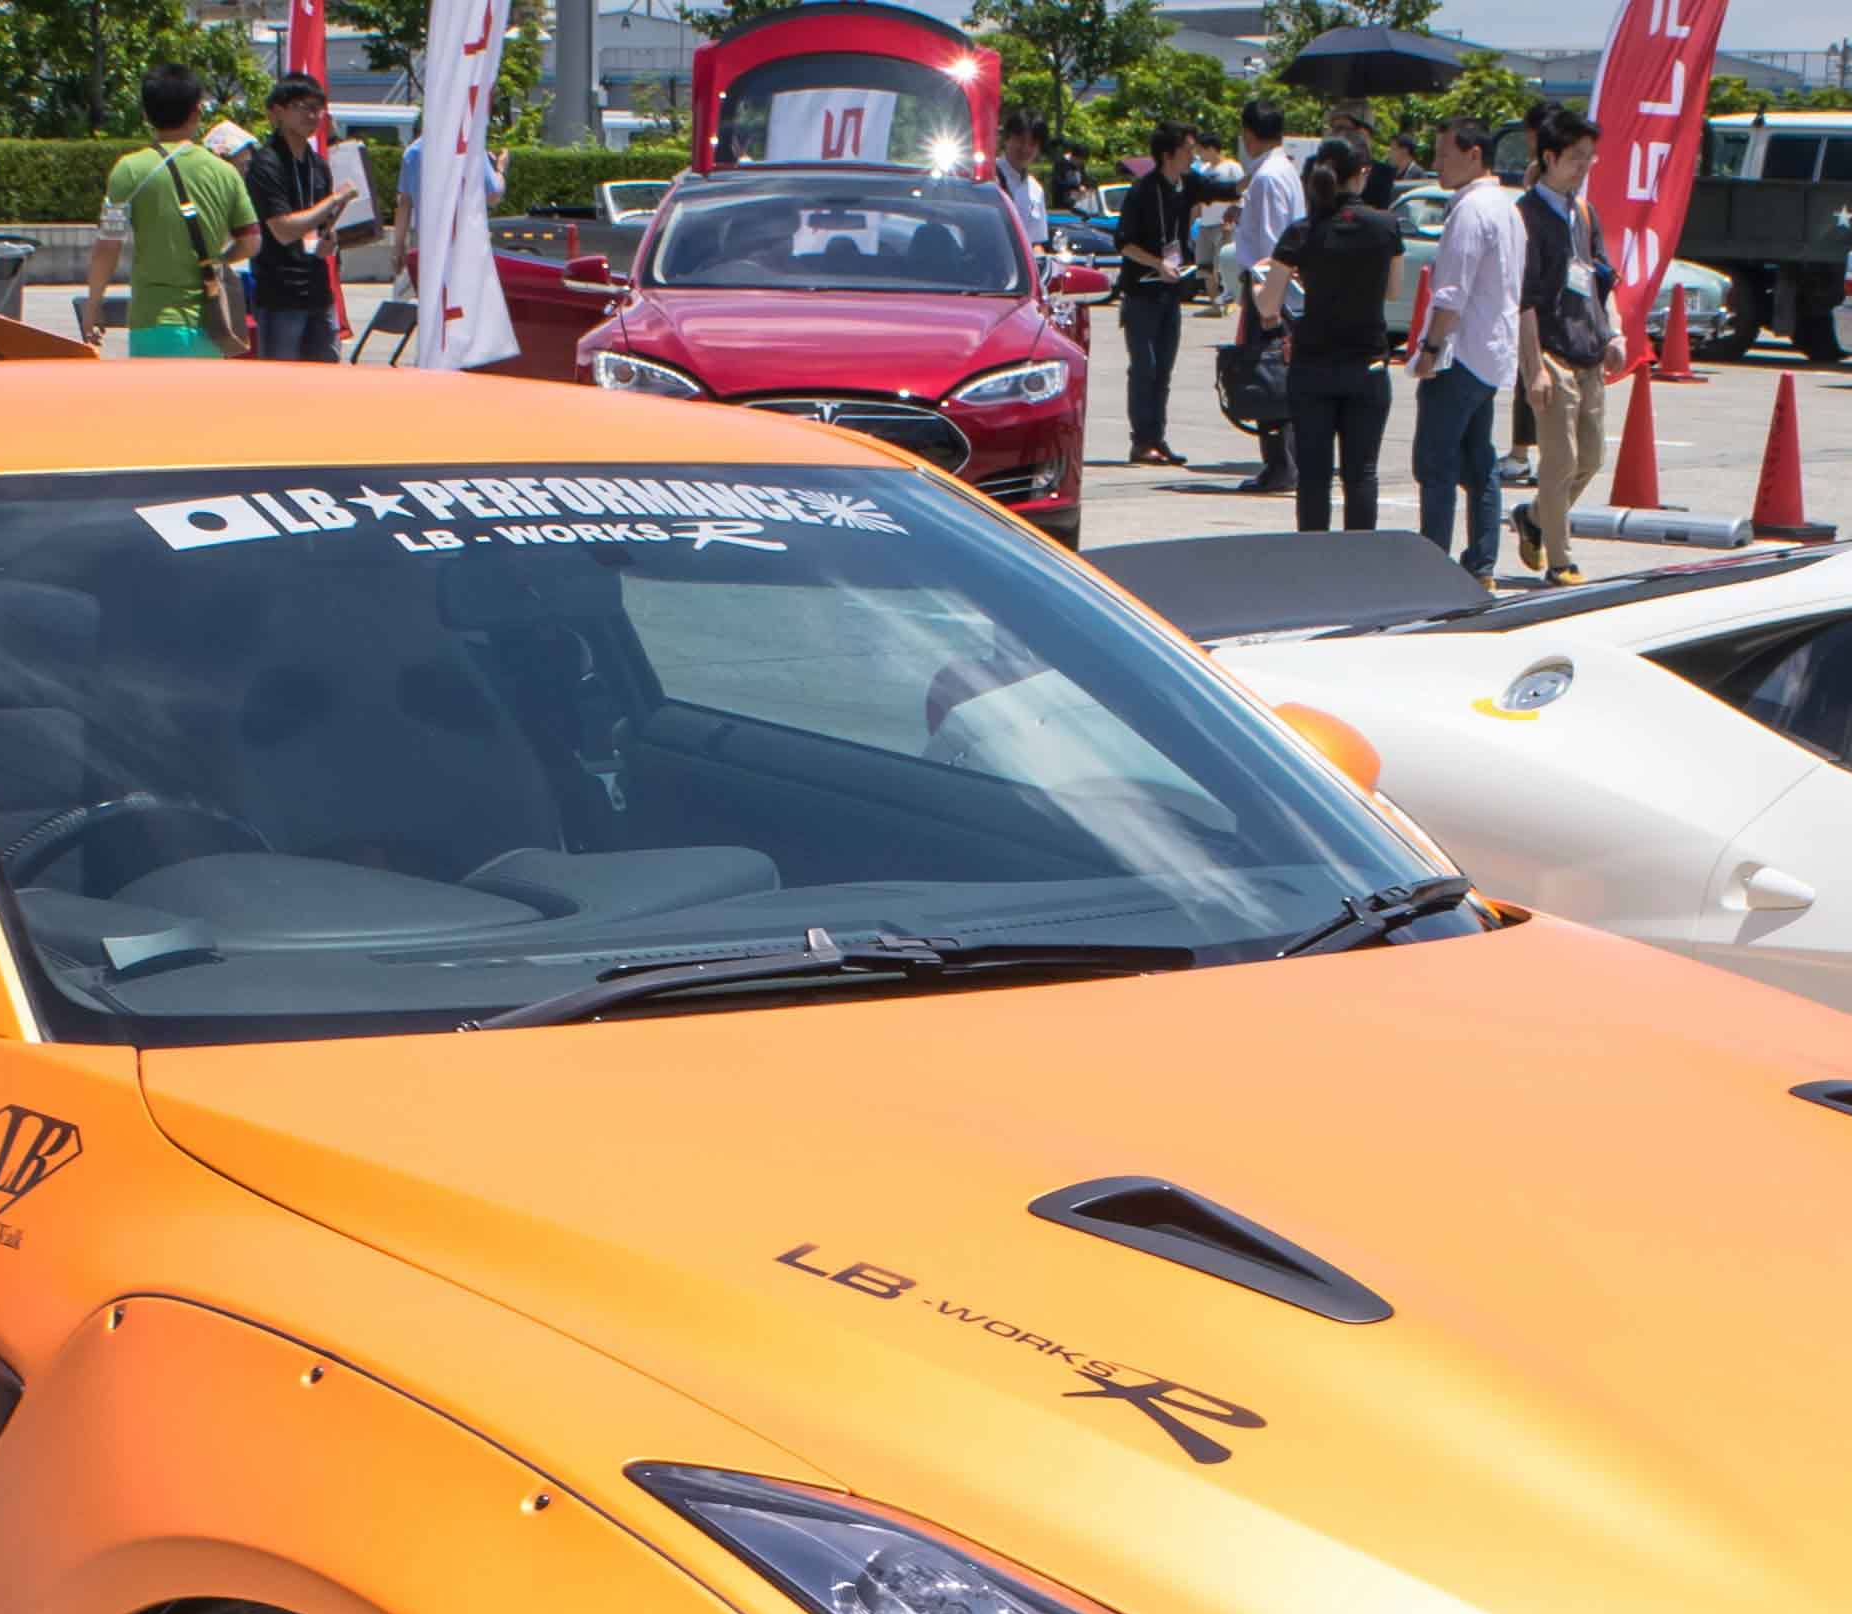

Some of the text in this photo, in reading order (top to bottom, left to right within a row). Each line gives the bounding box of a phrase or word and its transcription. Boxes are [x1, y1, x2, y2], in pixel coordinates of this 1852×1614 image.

[259, 477, 824, 534] LB PERFORMANCE
[390, 528, 466, 553] LB
[500, 519, 674, 548] WORKS
